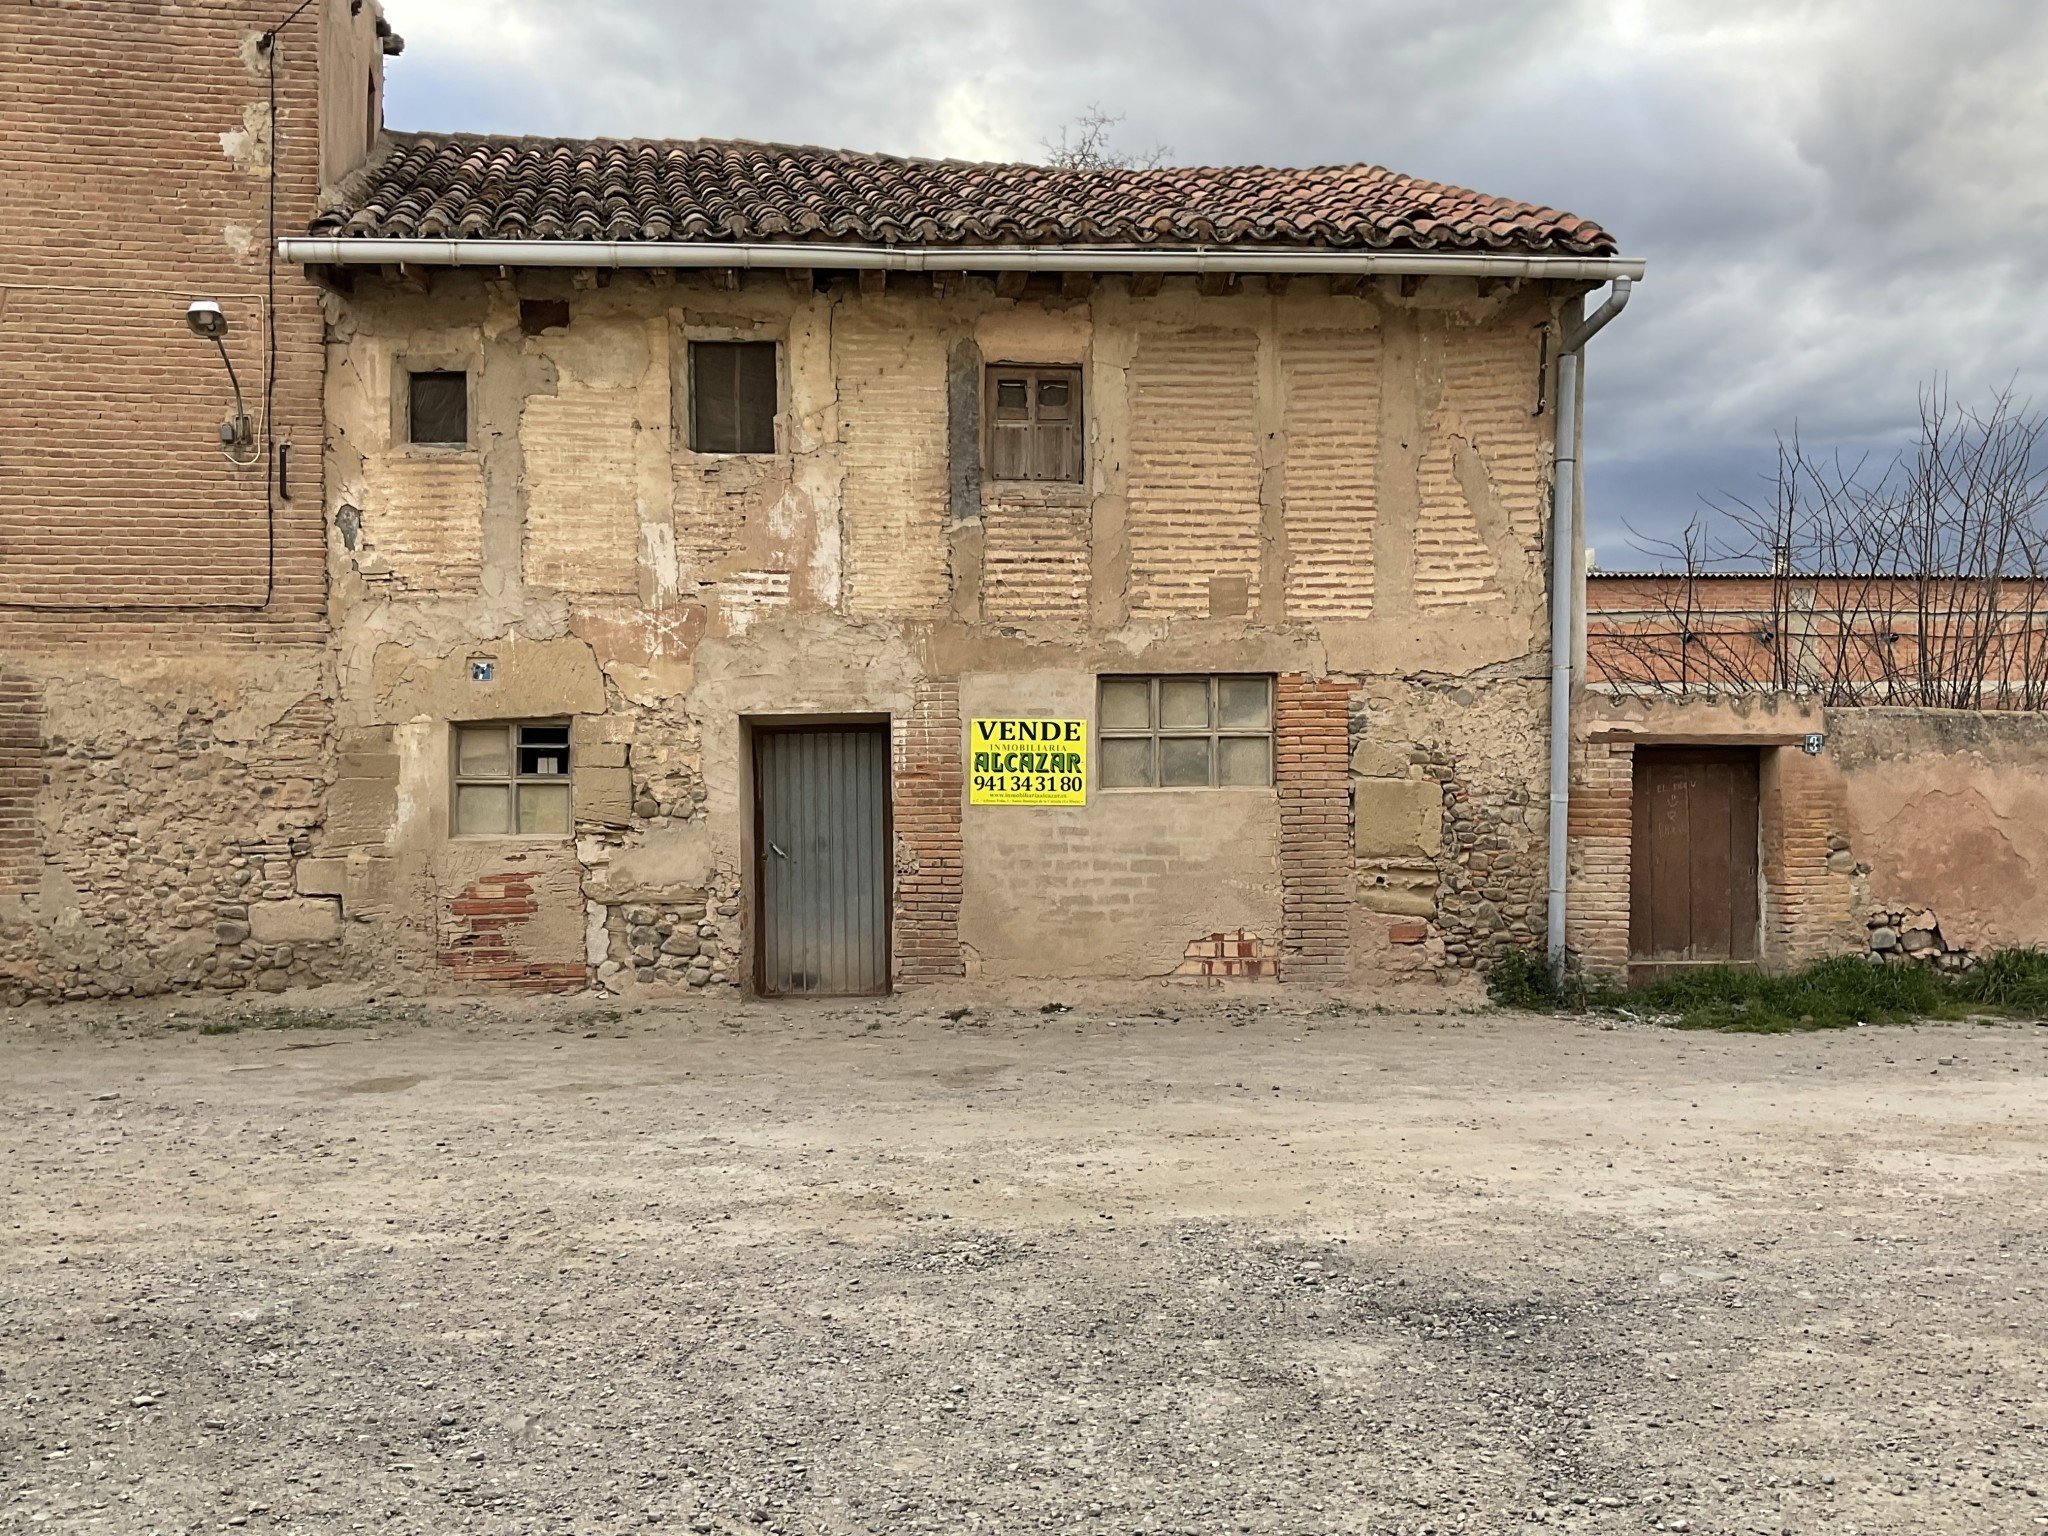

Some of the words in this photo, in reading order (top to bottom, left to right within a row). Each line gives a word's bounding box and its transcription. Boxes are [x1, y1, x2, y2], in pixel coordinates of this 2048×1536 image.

[976, 721, 1081, 741] VENDE
[990, 744, 1067, 752] INMOBILIARIA
[1809, 736, 1819, 752] 3
[973, 752, 1082, 773] ALCAZAR
[974, 775, 1007, 791] 941
[1010, 775, 1032, 791] 34
[1035, 776, 1057, 791] 31
[1060, 776, 1082, 792] 80
